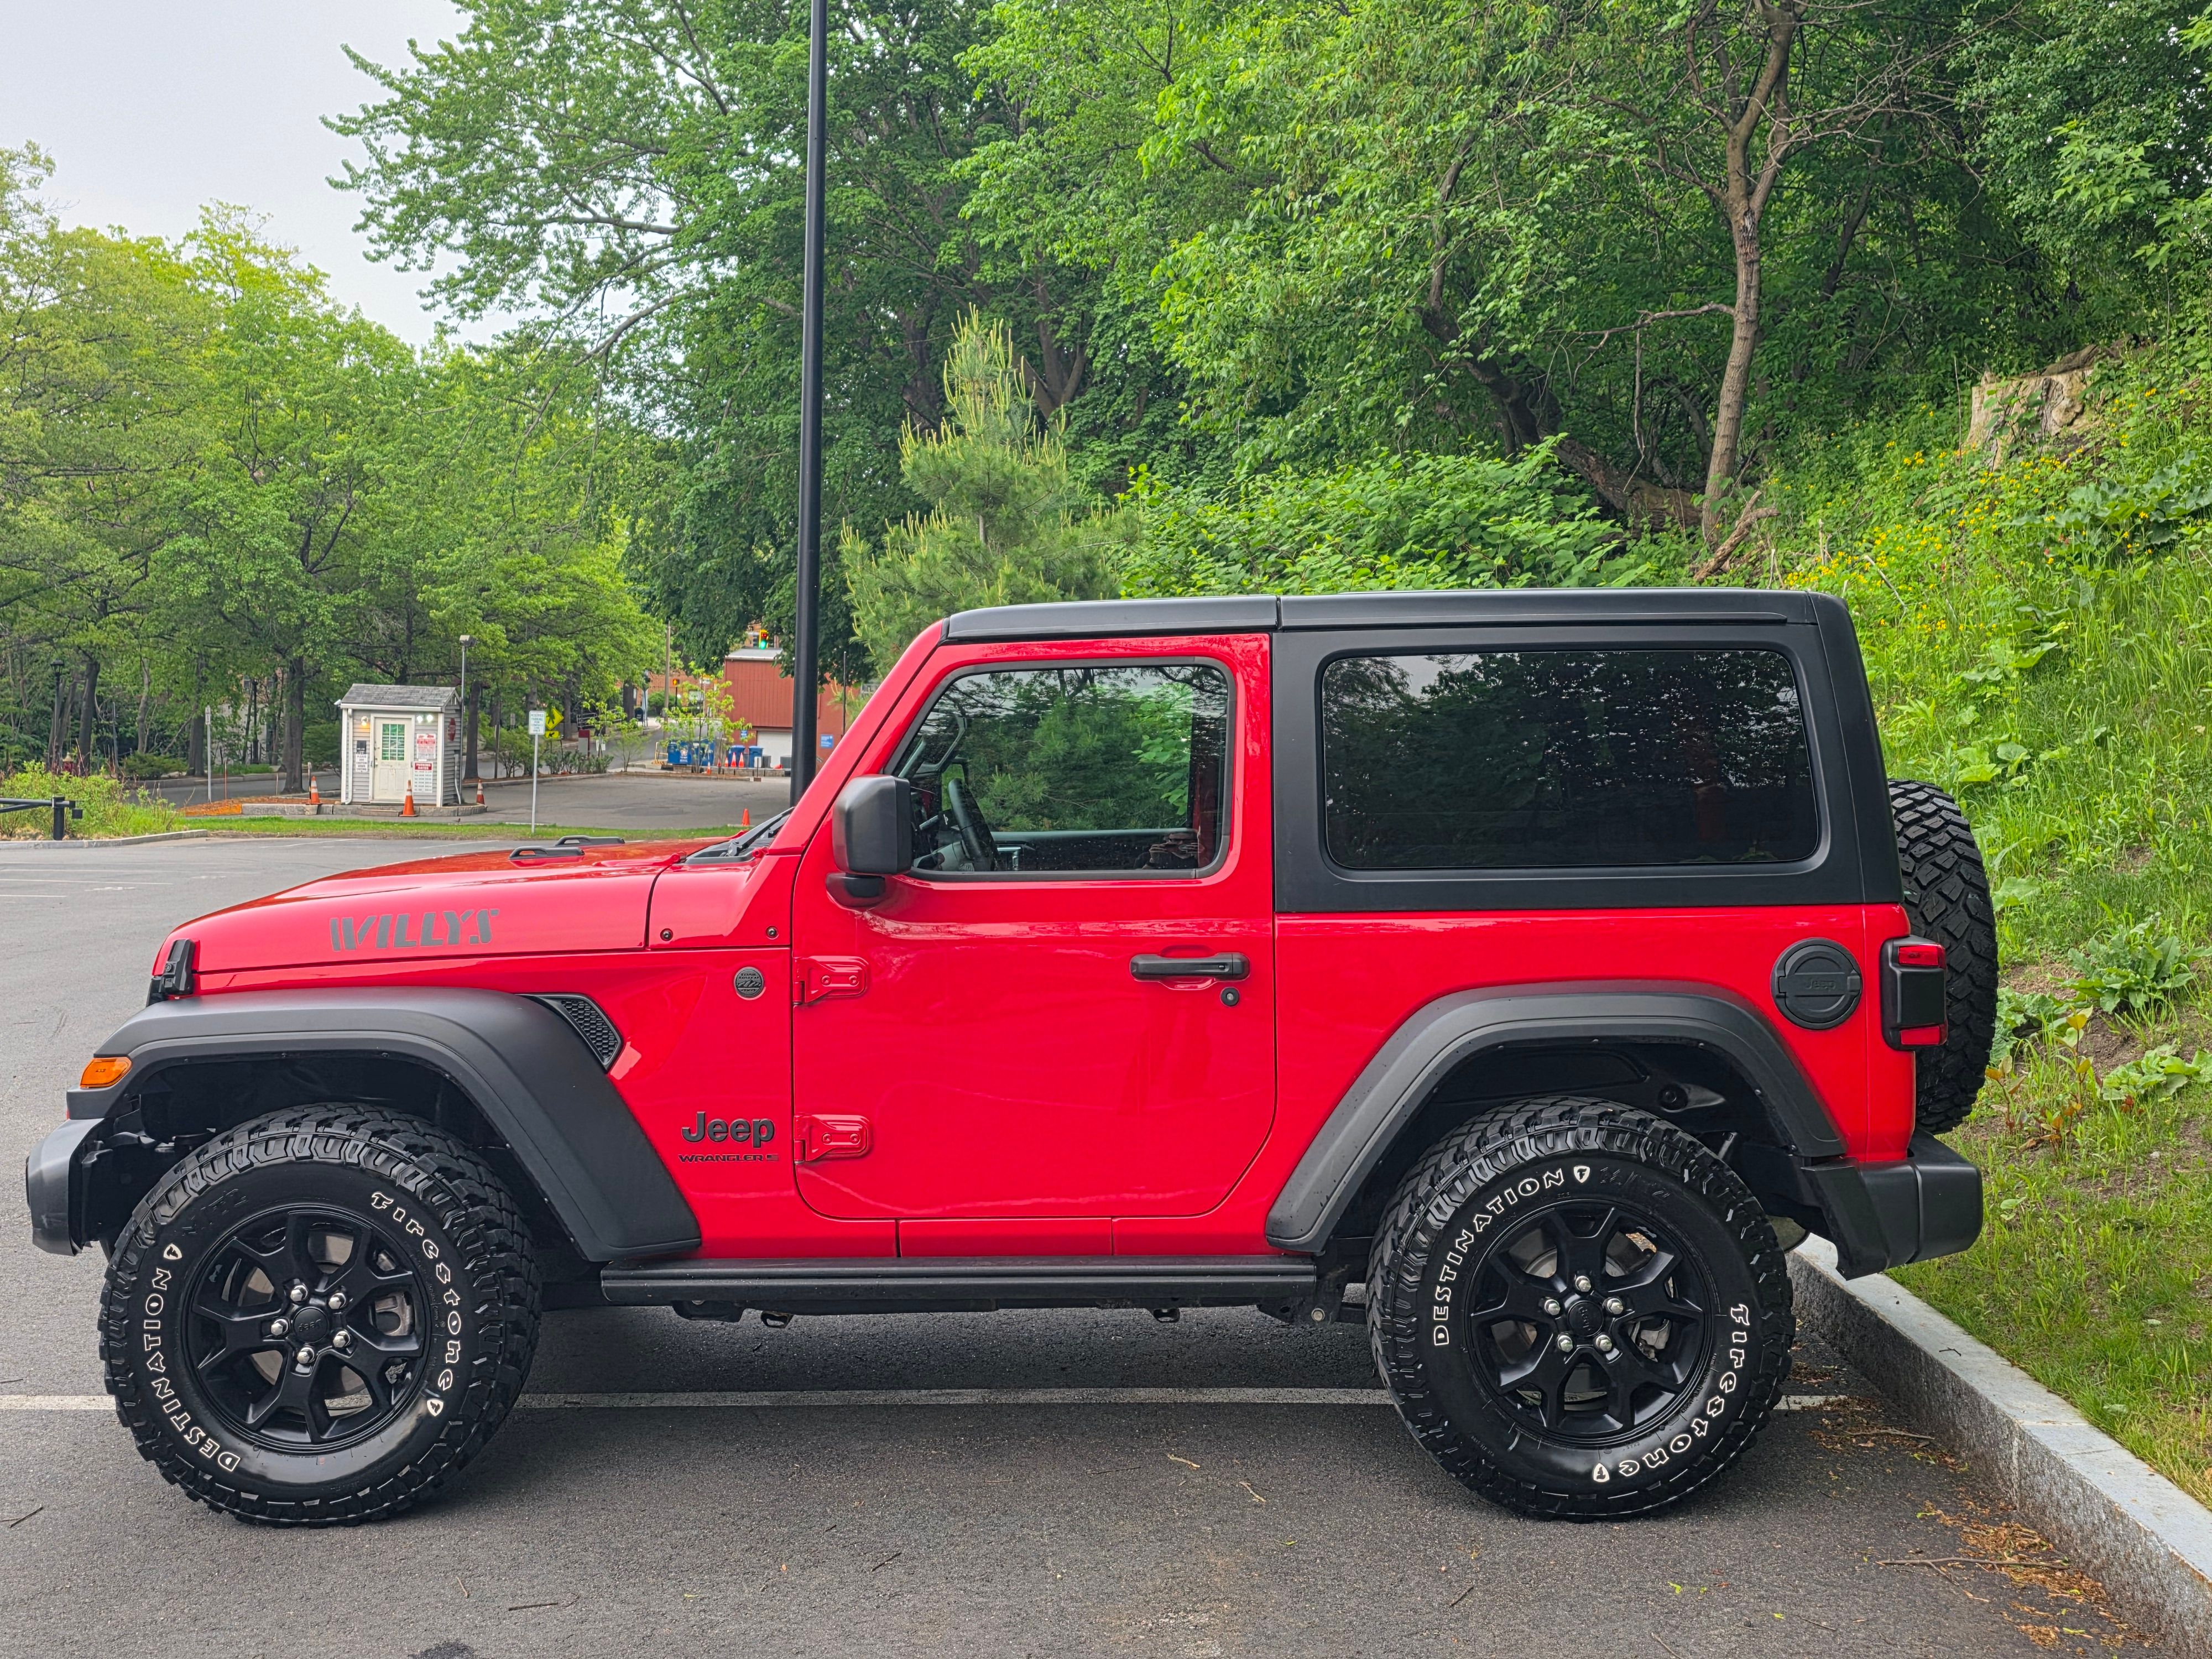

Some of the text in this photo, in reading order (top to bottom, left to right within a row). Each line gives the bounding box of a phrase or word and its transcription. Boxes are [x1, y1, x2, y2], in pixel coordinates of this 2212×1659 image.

[329, 909, 500, 952] WILLYS
[678, 1154, 764, 1163] WRANGLER
[681, 1111, 775, 1149] Jeep
[371, 1191, 461, 1391] Firestone
[1433, 1167, 1564, 1347] DESTINATION
[143, 1267, 241, 1472] DESTINATION
[1618, 1303, 1749, 1478] Firestone
